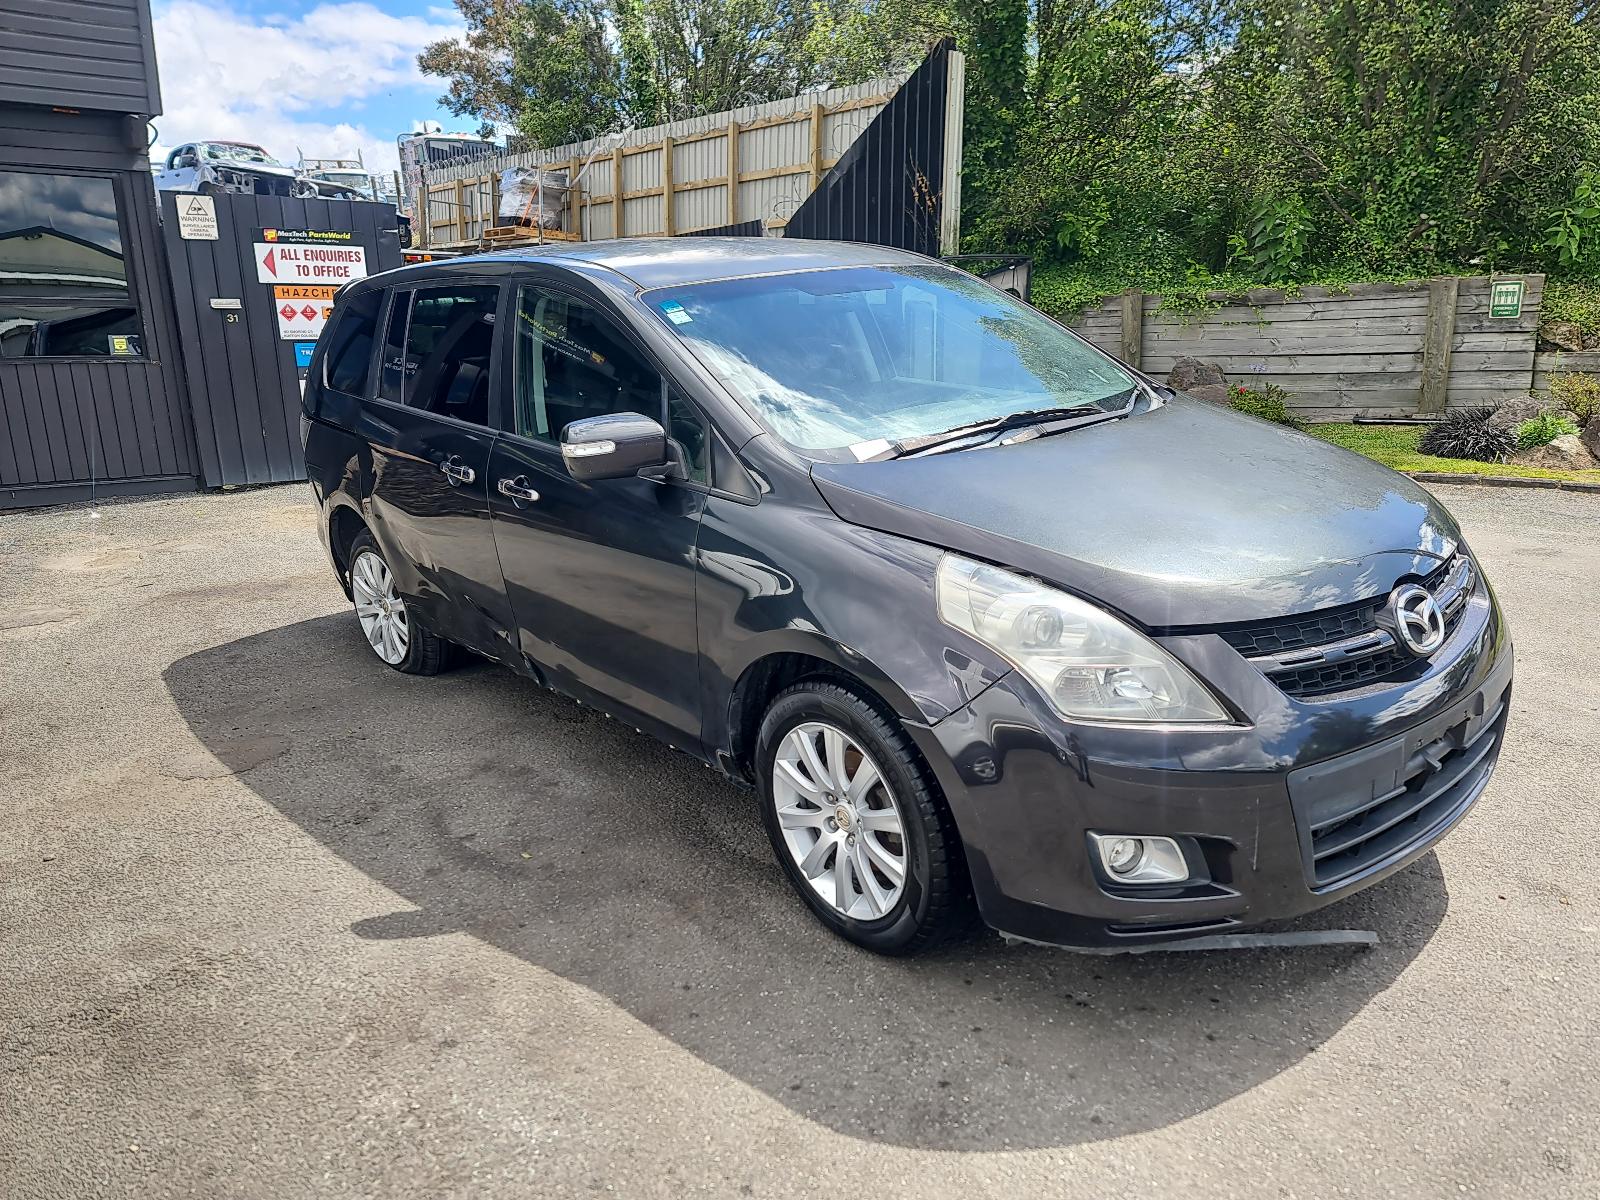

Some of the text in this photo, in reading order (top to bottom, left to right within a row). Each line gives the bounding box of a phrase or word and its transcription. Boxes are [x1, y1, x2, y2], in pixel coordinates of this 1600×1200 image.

[308, 231, 351, 239] PartsWorld
[280, 248, 361, 263] ALL ENQUIRIES
[296, 264, 351, 278] TO OFFICE
[227, 313, 239, 323] 31
